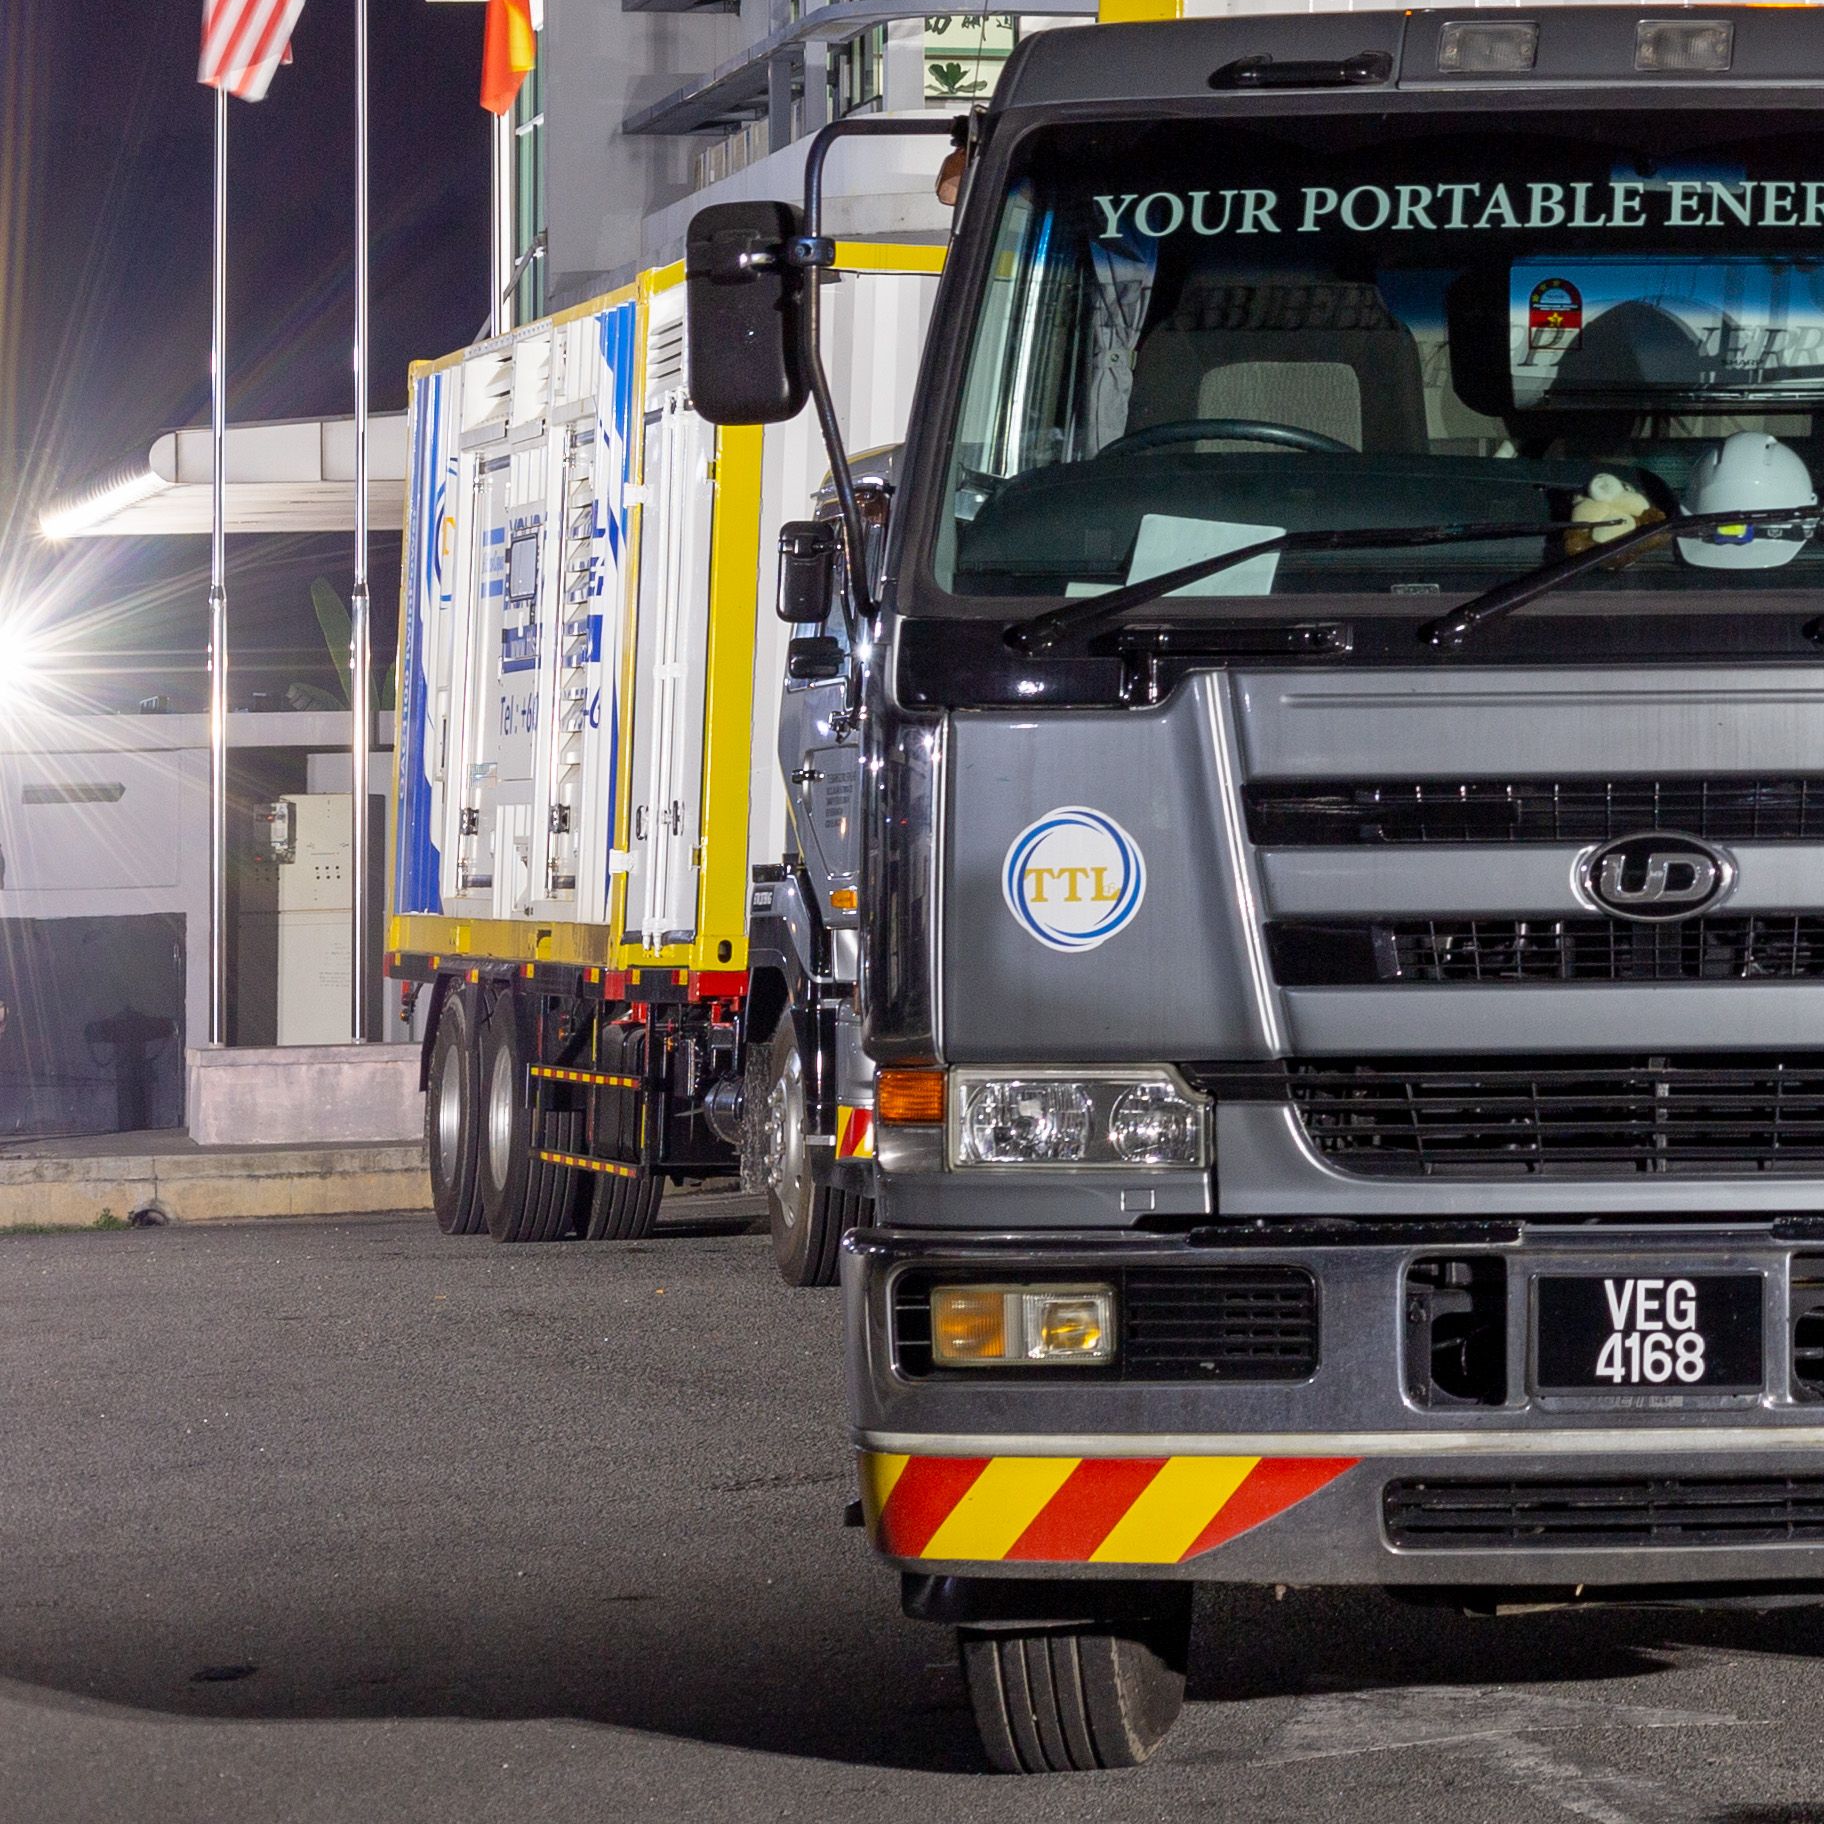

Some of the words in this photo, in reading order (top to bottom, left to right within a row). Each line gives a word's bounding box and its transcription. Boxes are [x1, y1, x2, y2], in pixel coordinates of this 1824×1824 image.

[1093, 190, 1280, 239] YOUR
[1299, 181, 1649, 233] PORTABLE
[1023, 867, 1122, 903] TTL
[1600, 852, 1715, 904] UD
[1601, 1280, 1698, 1333] VEG
[1594, 1332, 1708, 1384] 4168
